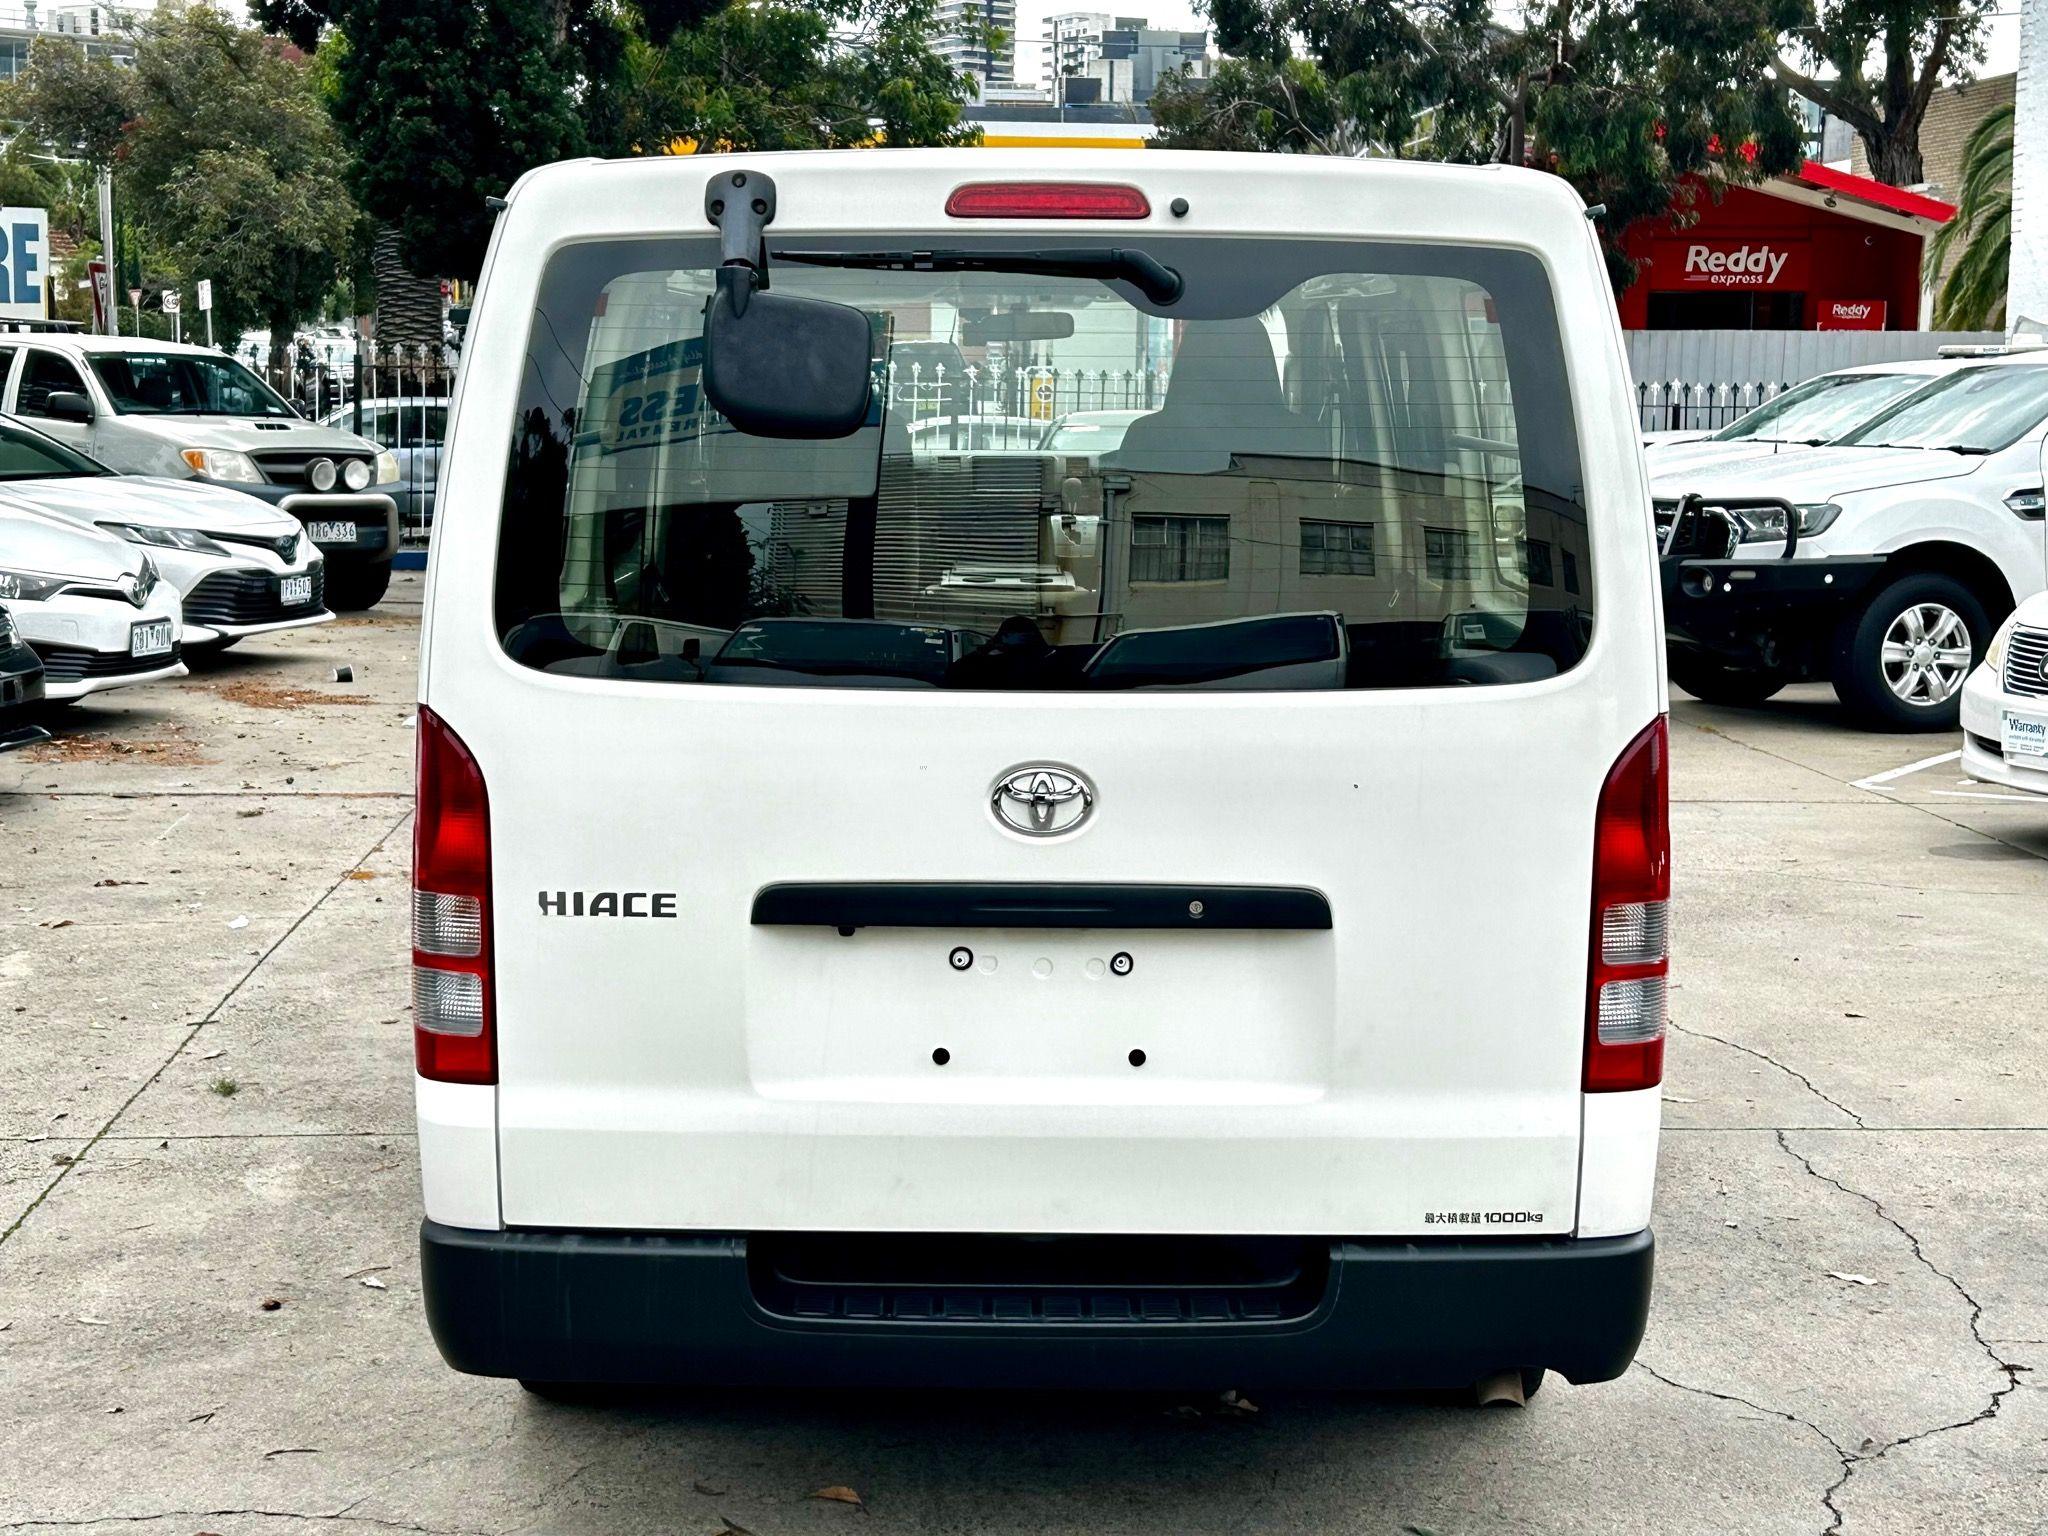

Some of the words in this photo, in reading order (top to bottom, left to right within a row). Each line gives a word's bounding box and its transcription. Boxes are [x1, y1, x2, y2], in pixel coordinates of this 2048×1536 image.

[1685, 245, 1789, 284] Reddy
[1710, 274, 1764, 287] express
[1832, 303, 1871, 319] Reddy
[538, 891, 678, 918] HIACE
[1484, 1211, 1543, 1224] 1000kg
